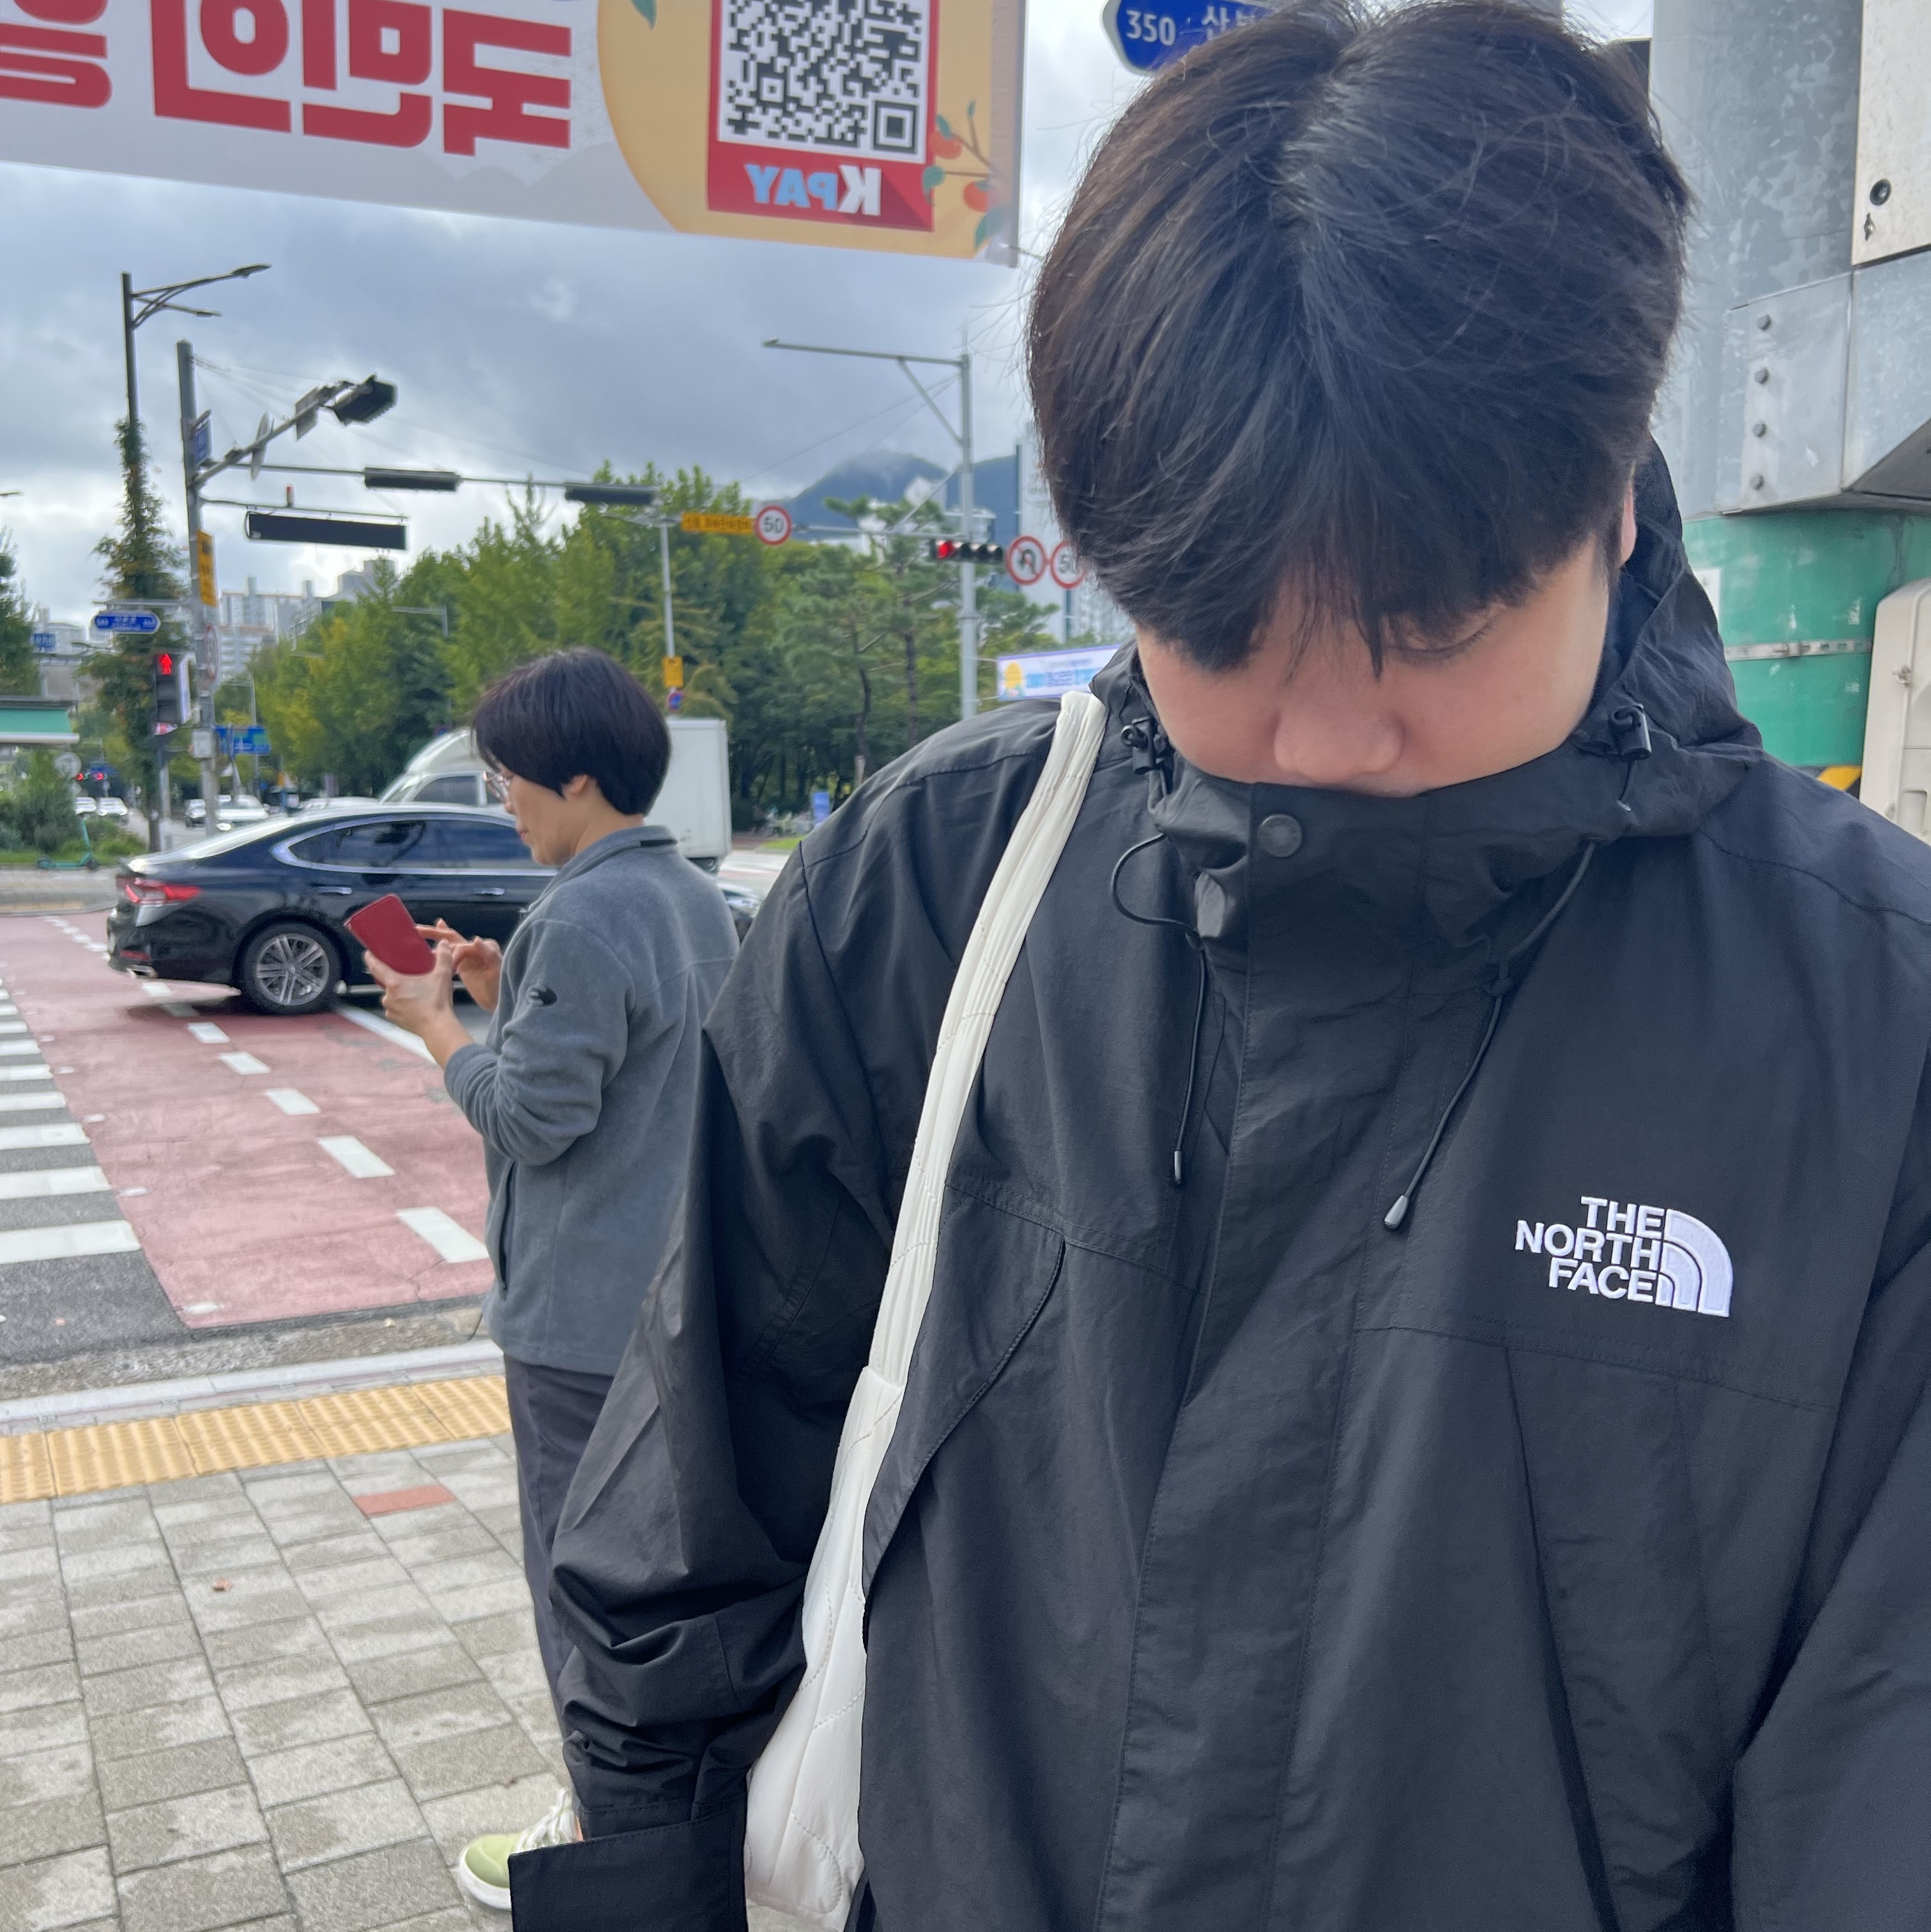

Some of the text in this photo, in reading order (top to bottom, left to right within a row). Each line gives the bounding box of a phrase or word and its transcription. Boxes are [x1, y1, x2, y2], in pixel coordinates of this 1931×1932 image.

[1126, 9, 1177, 46] 350
[762, 516, 785, 535] 50
[1580, 1196, 1665, 1239] THE
[1515, 1219, 1661, 1271] NORTH
[1548, 1256, 1658, 1304] FACE
